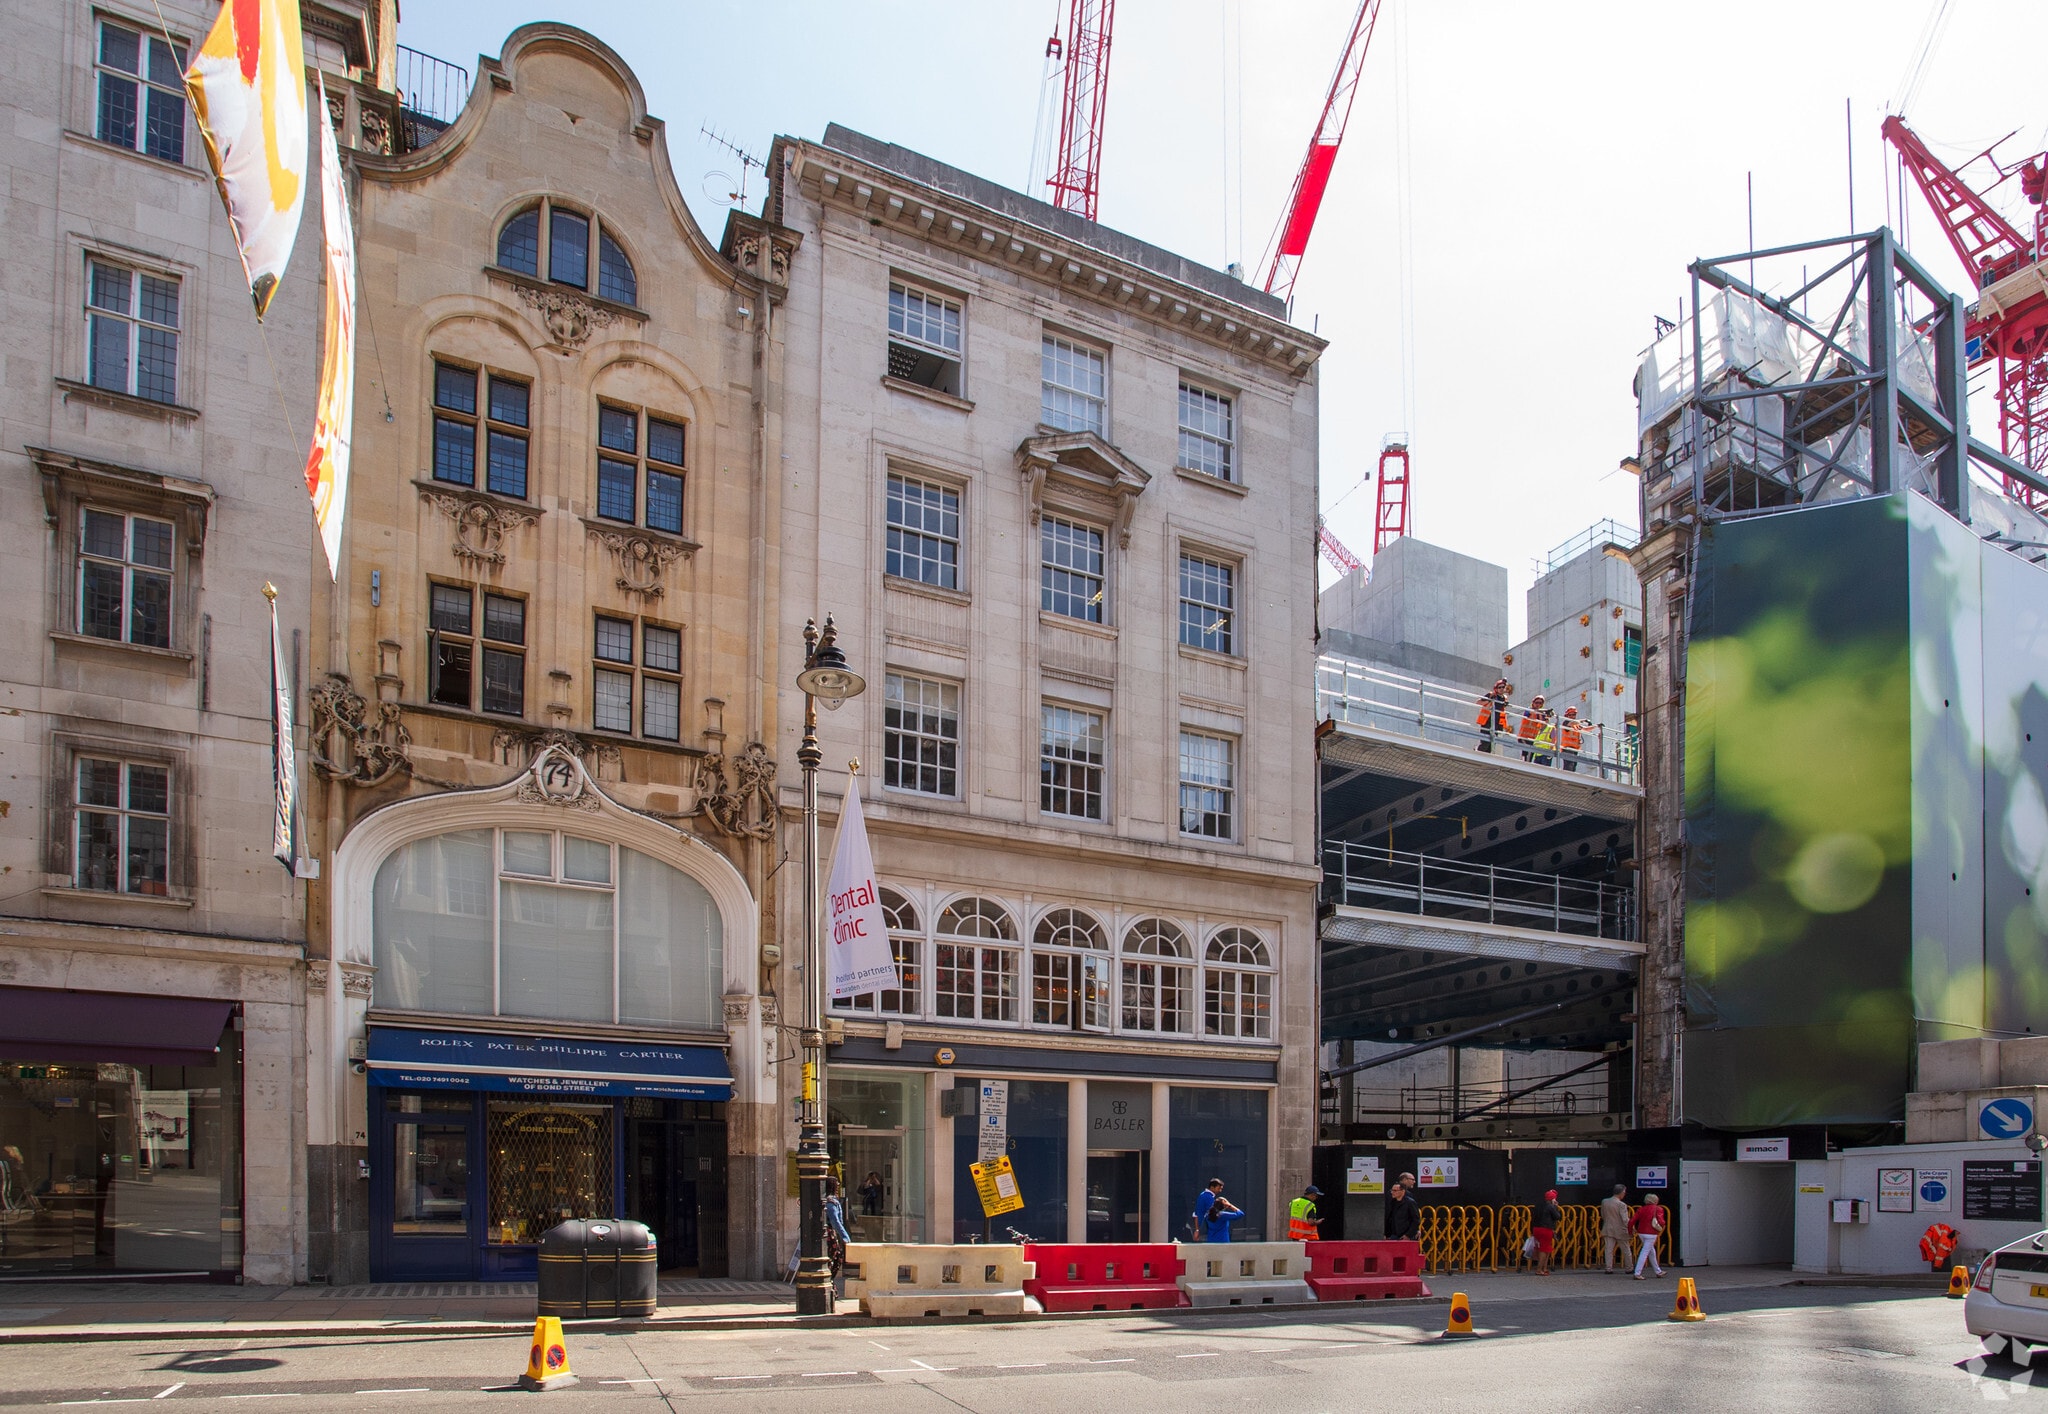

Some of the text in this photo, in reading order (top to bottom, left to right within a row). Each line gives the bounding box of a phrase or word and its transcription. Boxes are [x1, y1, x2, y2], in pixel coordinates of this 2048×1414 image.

[546, 763, 572, 787] 74
[831, 880, 875, 917] Dental
[834, 915, 867, 944] Clinic
[858, 965, 892, 979] partners
[421, 1039, 684, 1060] ROLEX PATEK PHILIPPE CARTIER
[560, 1079, 610, 1087] JEWELLERY
[1094, 1118, 1145, 1131] BASLER
[355, 1131, 366, 1139] 74
[1213, 1139, 1224, 1153] 73
